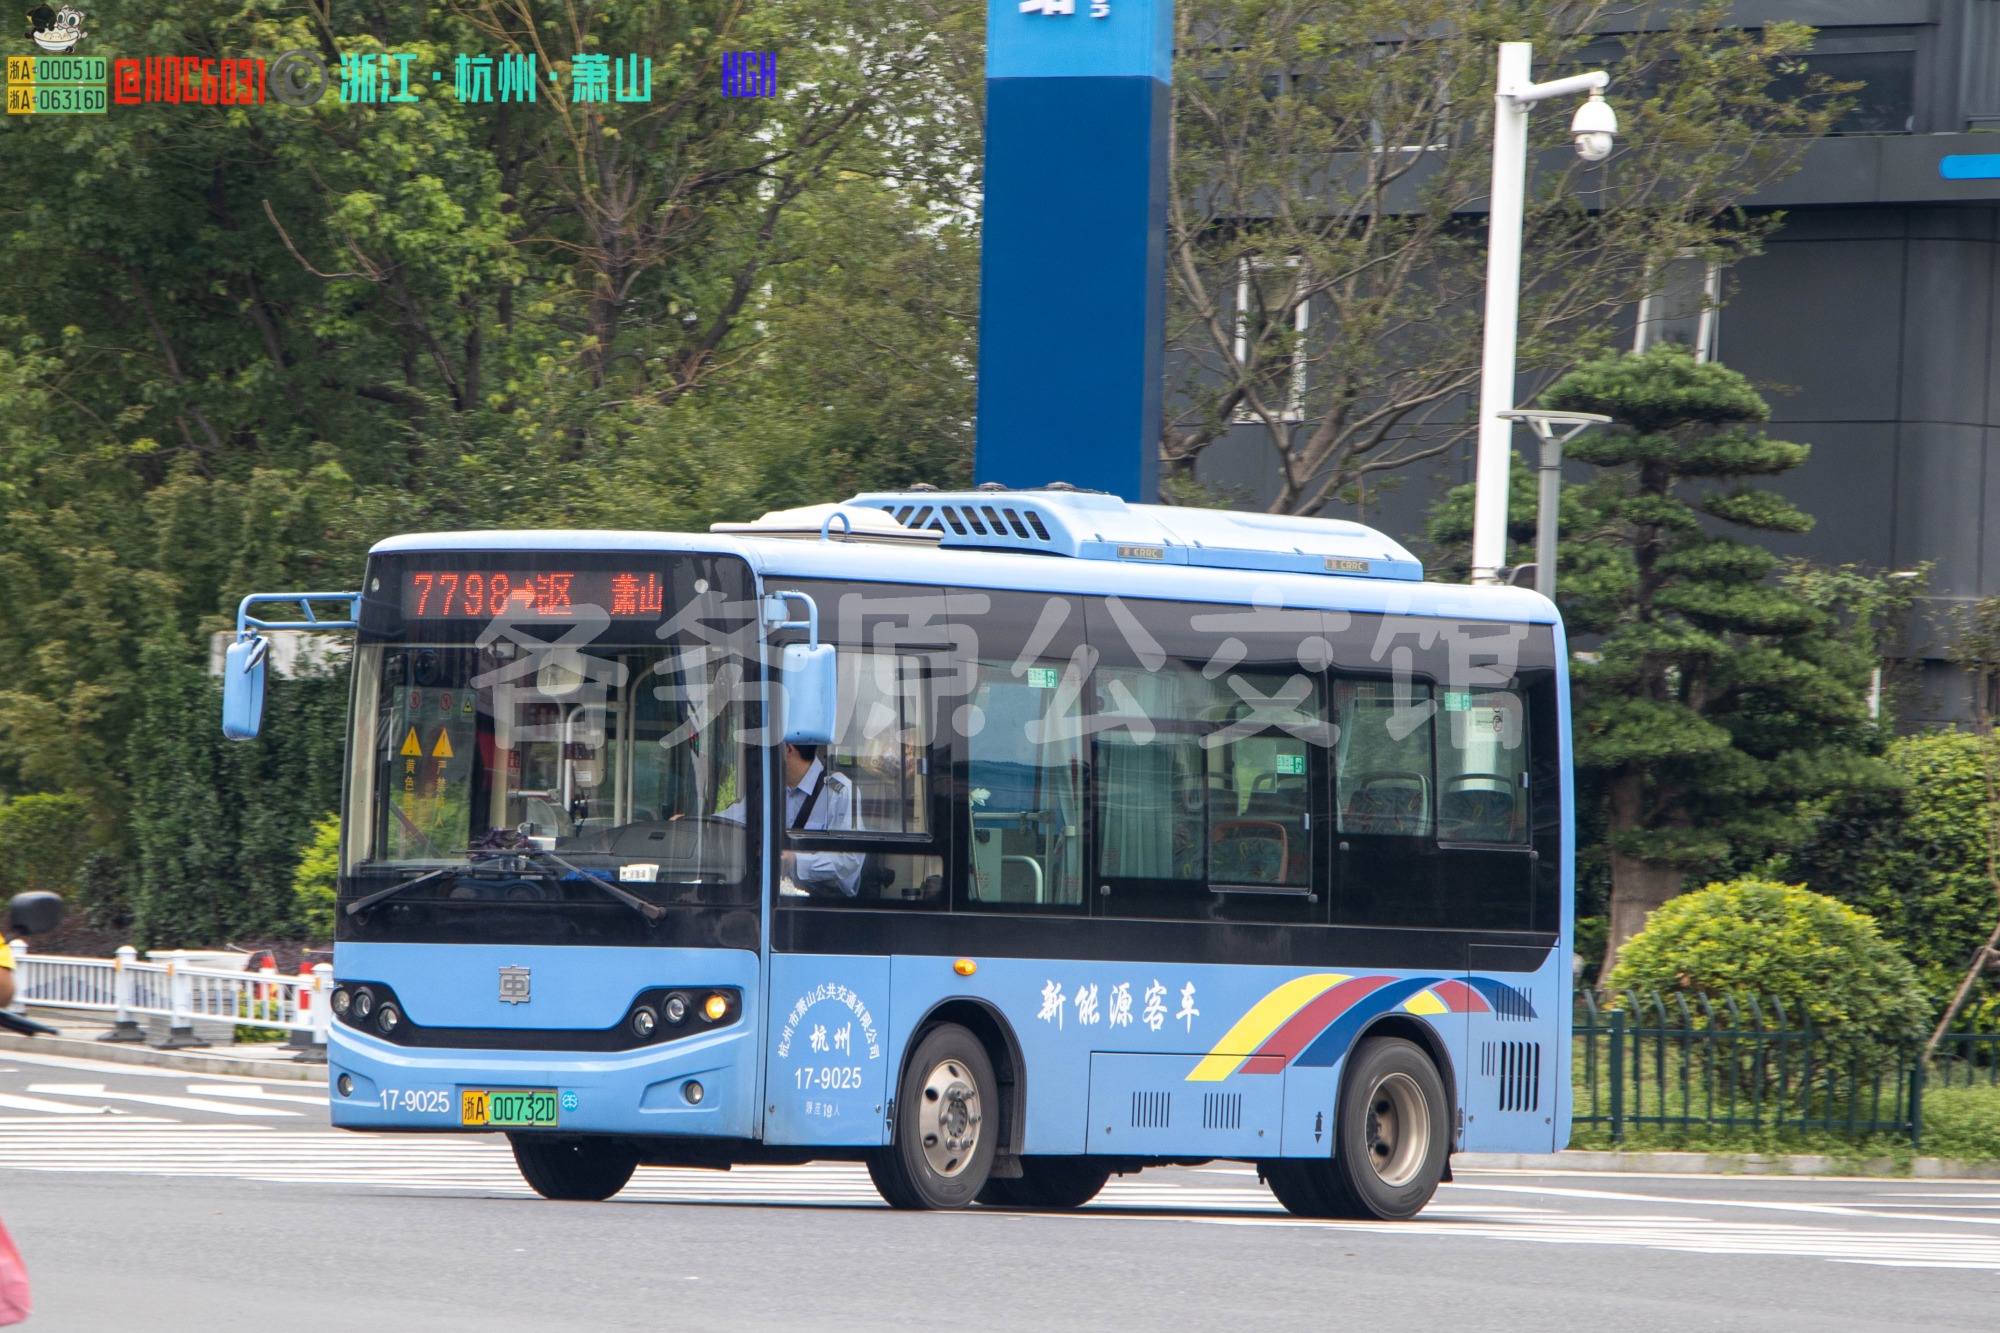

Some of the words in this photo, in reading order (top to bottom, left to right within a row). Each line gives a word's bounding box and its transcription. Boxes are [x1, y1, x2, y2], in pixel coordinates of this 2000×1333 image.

[1133, 548, 1158, 558] CRRC
[1340, 561, 1363, 571] CRRC
[1037, 978, 1200, 1034] 新能源客车
[809, 1021, 852, 1057] 杭州
[794, 1067, 862, 1090] 17-9025
[379, 1089, 450, 1113] 17-9025
